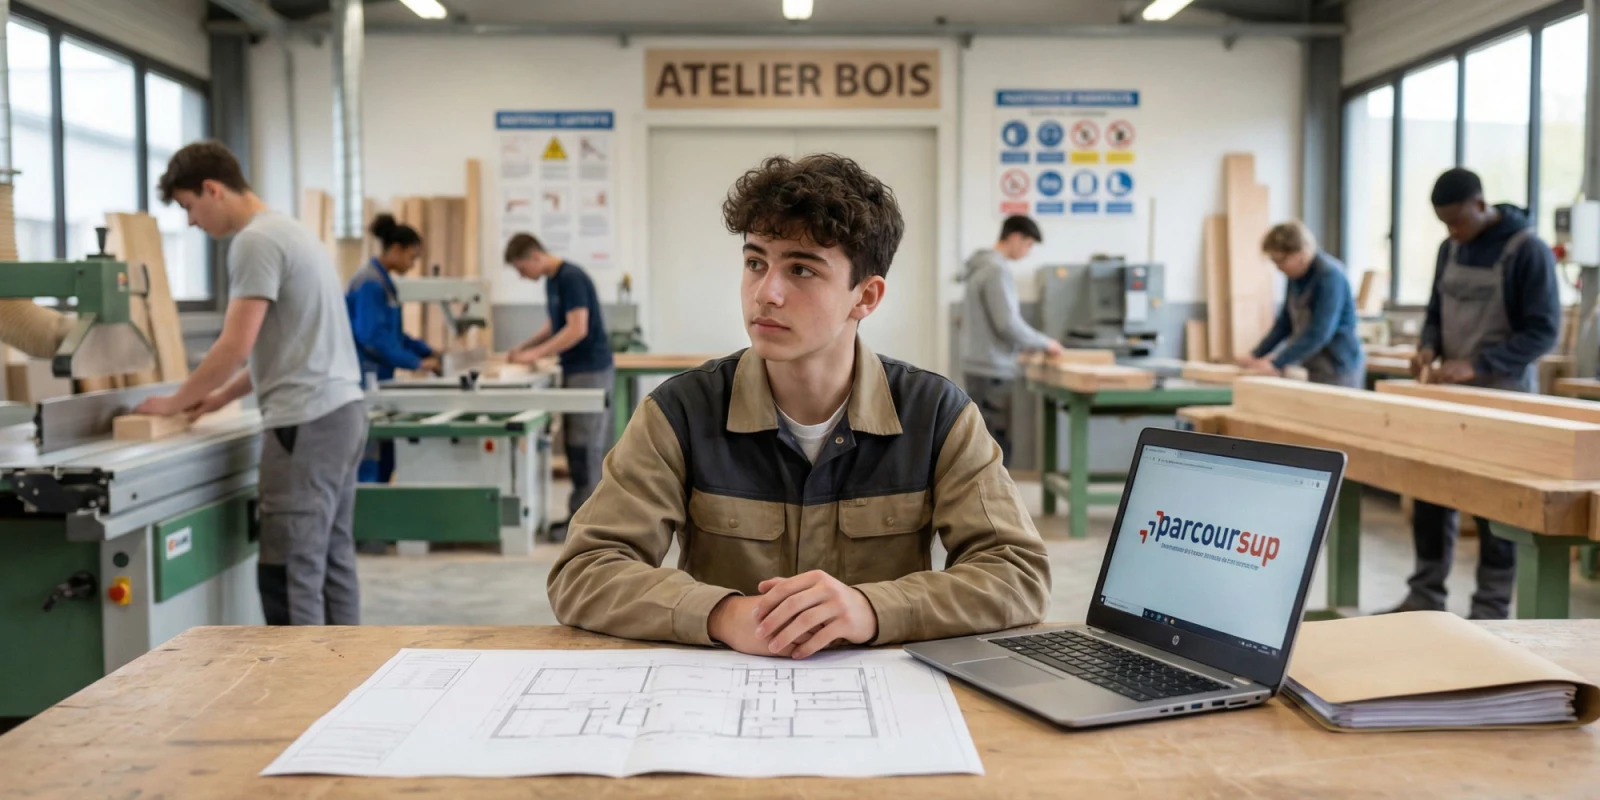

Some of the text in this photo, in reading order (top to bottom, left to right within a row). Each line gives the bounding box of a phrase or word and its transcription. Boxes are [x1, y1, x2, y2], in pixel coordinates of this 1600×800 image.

[655, 62, 931, 98] ATELIER BOIS
[1155, 515, 1280, 567] parcoursup
